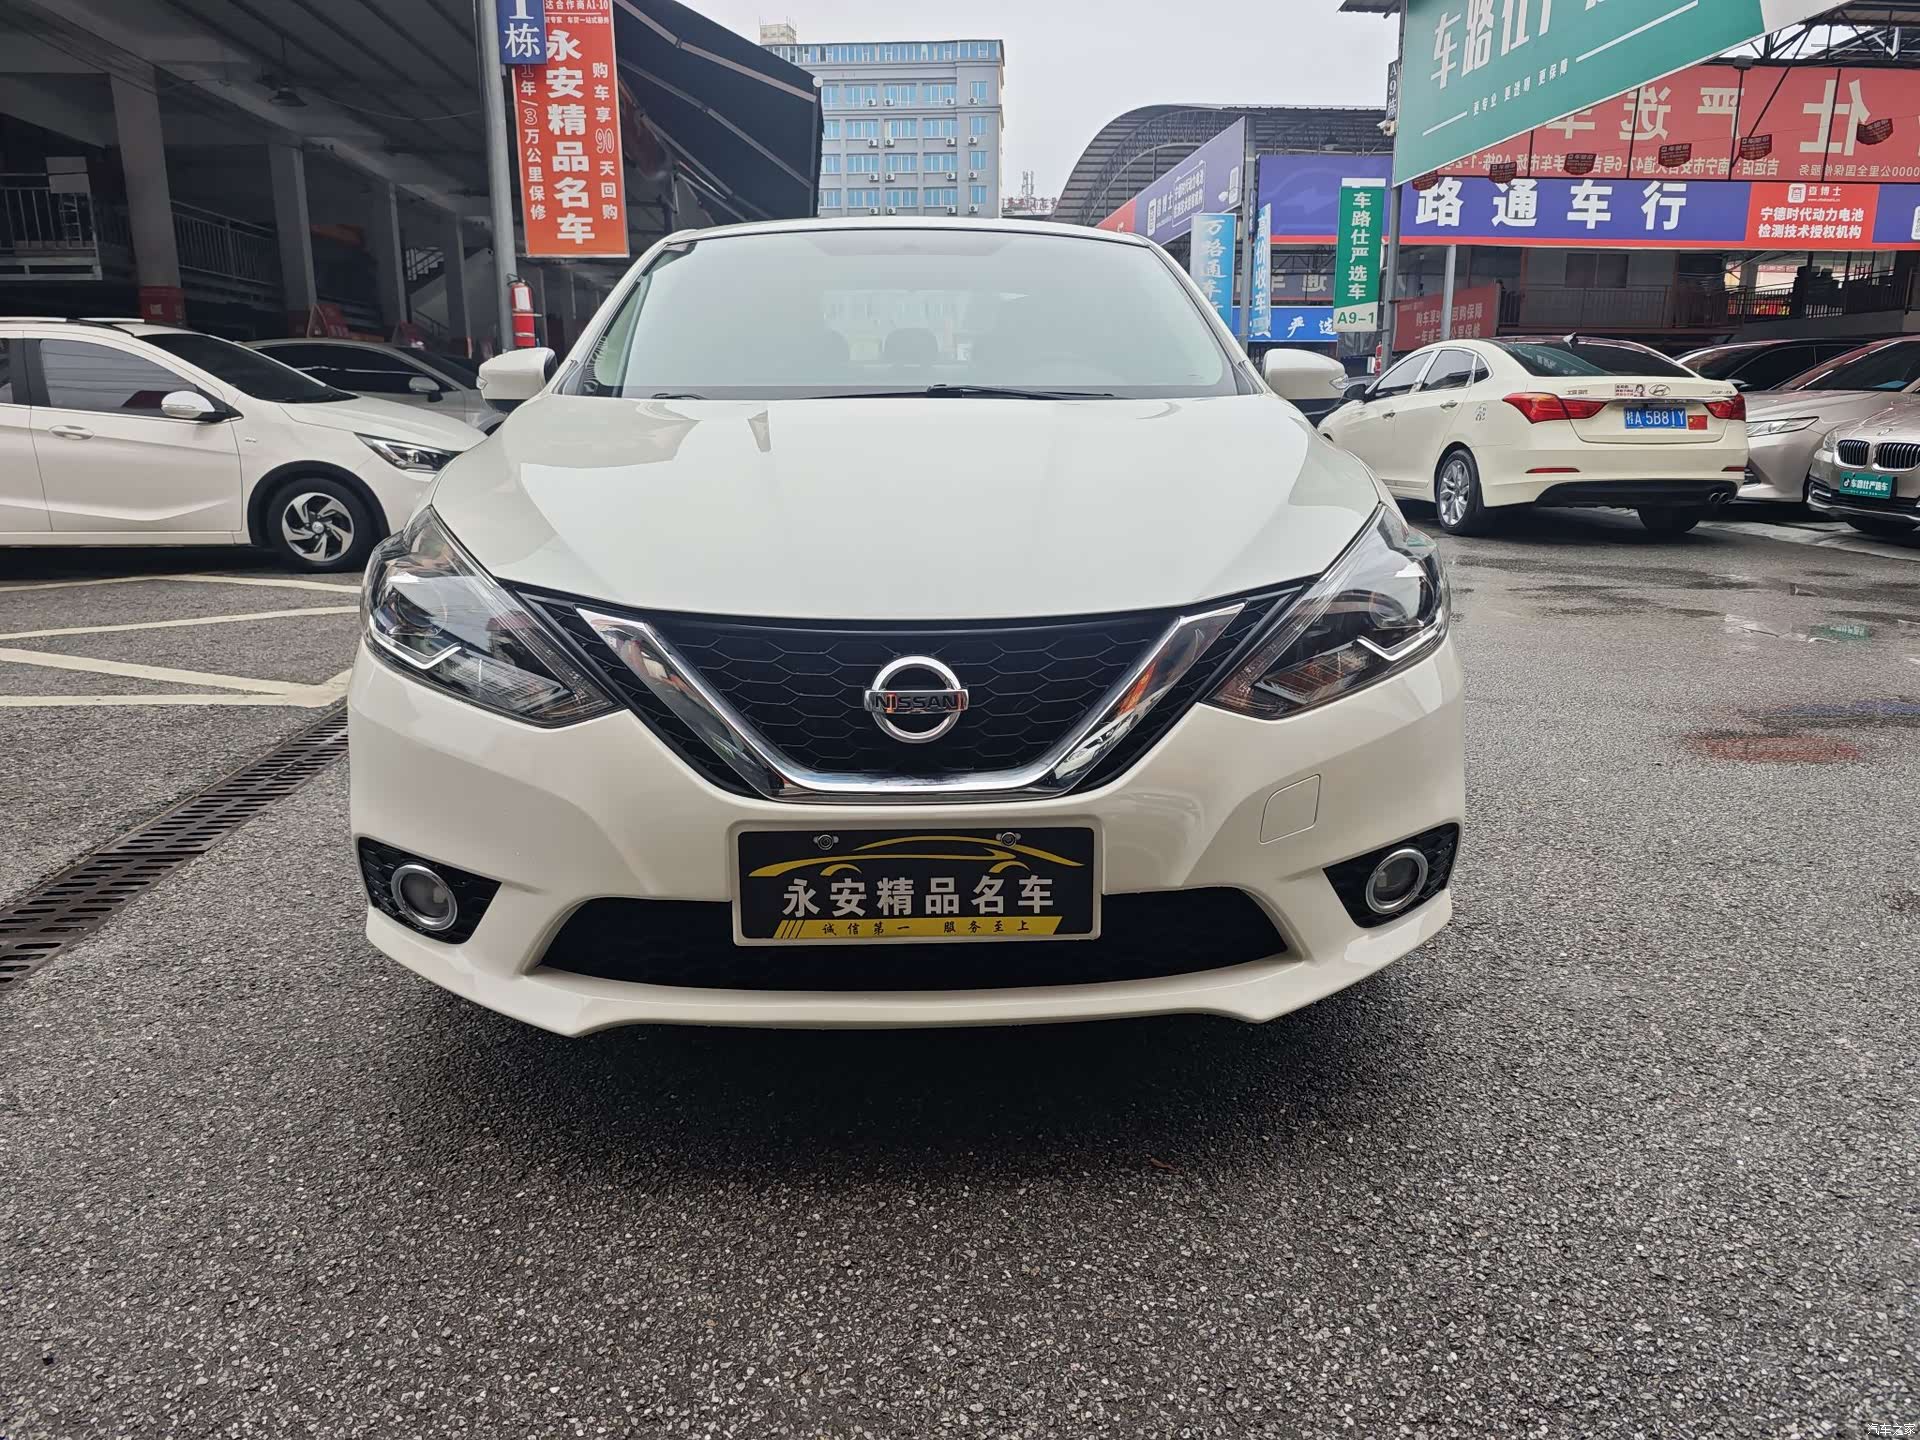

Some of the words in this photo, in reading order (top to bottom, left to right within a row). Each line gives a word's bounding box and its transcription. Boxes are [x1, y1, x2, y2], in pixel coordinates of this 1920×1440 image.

[1430, 0, 1600, 90] 车路仕
[546, 29, 595, 245] 永安精品名车
[592, 62, 618, 220] 购车享90天回购
[1415, 177, 1687, 230] 路通车行
[1760, 207, 1864, 222] 宁德时代动力电池
[1347, 192, 1371, 300] 车路仕严选车
[1758, 224, 1862, 239] 检测技术授权机构
[1337, 311, 1375, 325] A9-1
[875, 695, 957, 709] NISSAN
[782, 875, 1054, 917] 永安精品名车
[821, 921, 910, 936] 诚信第一
[943, 919, 1030, 934] 服务至上
